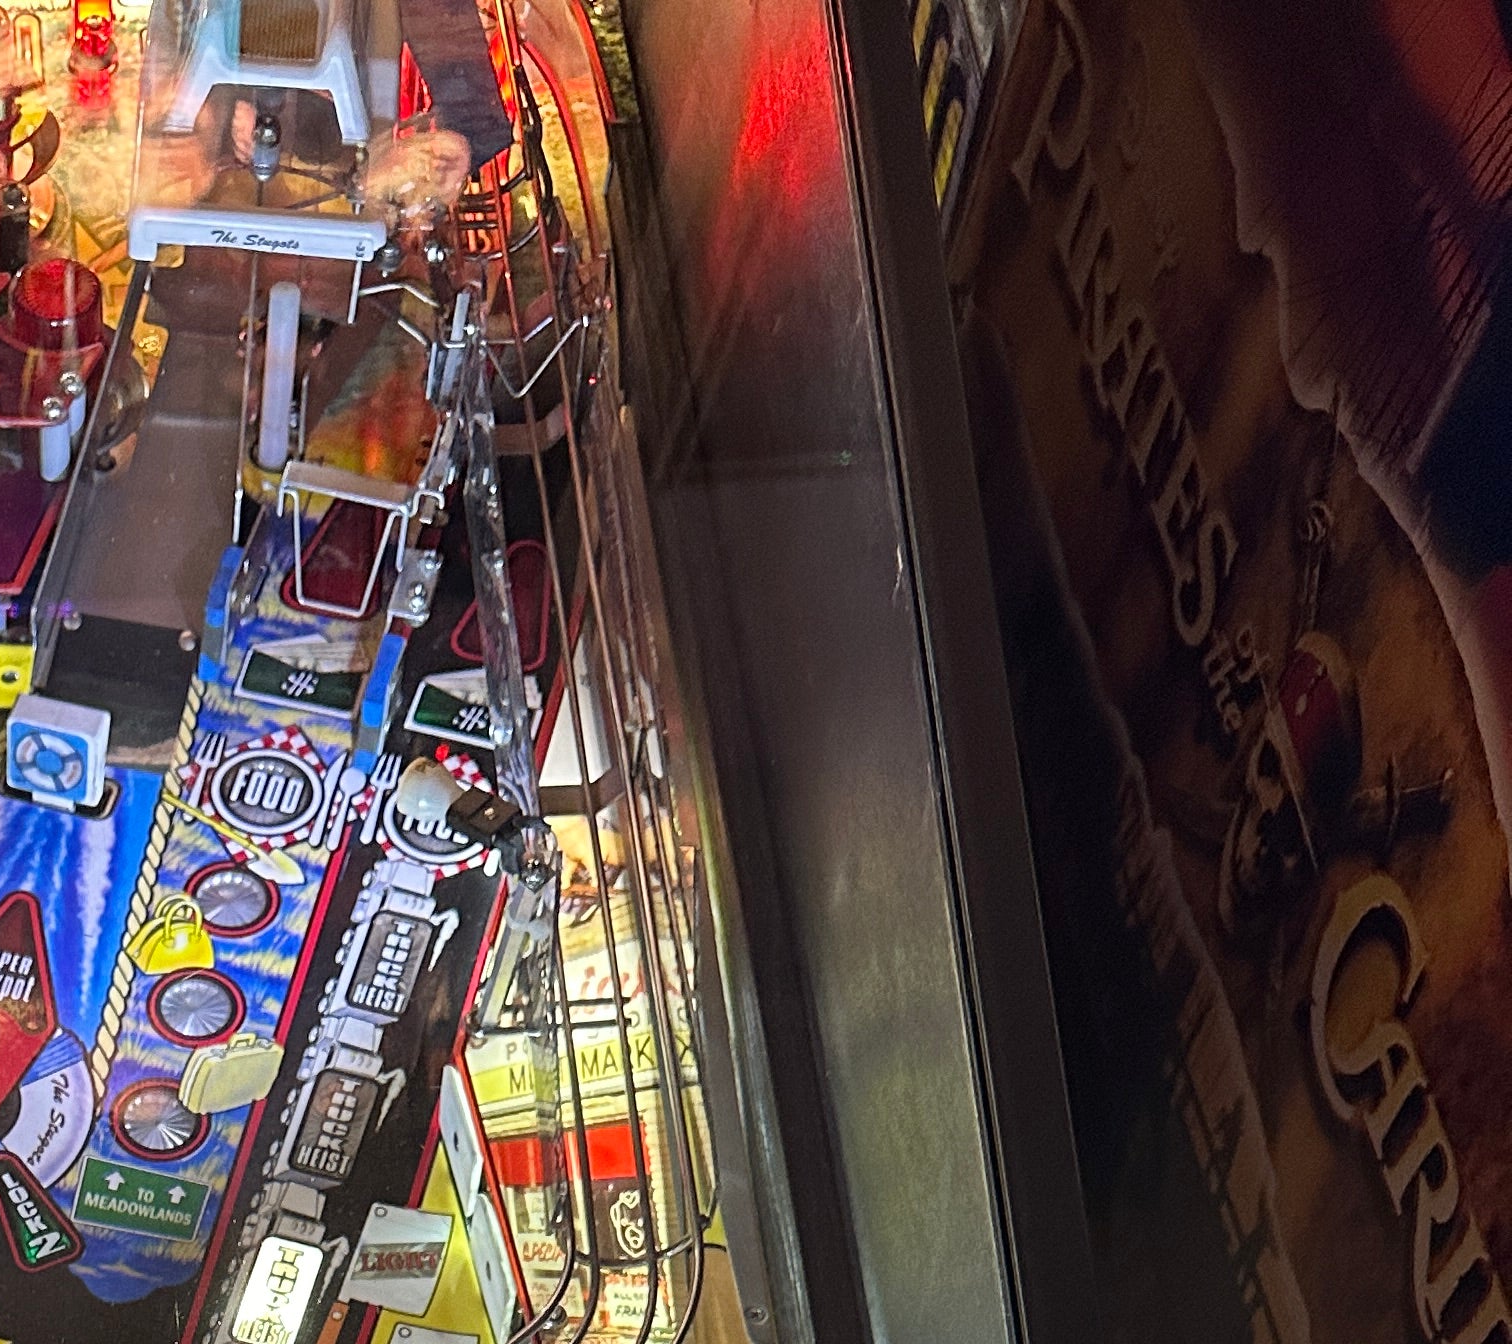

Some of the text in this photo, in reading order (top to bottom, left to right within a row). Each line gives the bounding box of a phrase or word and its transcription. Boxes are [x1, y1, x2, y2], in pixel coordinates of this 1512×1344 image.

[211, 230, 237, 244] The
[230, 769, 304, 815] FOOD
[353, 982, 407, 1012] HEIST
[318, 1079, 360, 1154] TRUCK
[297, 1144, 351, 1175] HEIST
[84, 1191, 193, 1226] MEADOWLANDS
[137, 1187, 155, 1204] TO
[1, 1171, 66, 1260] LOCK 2
